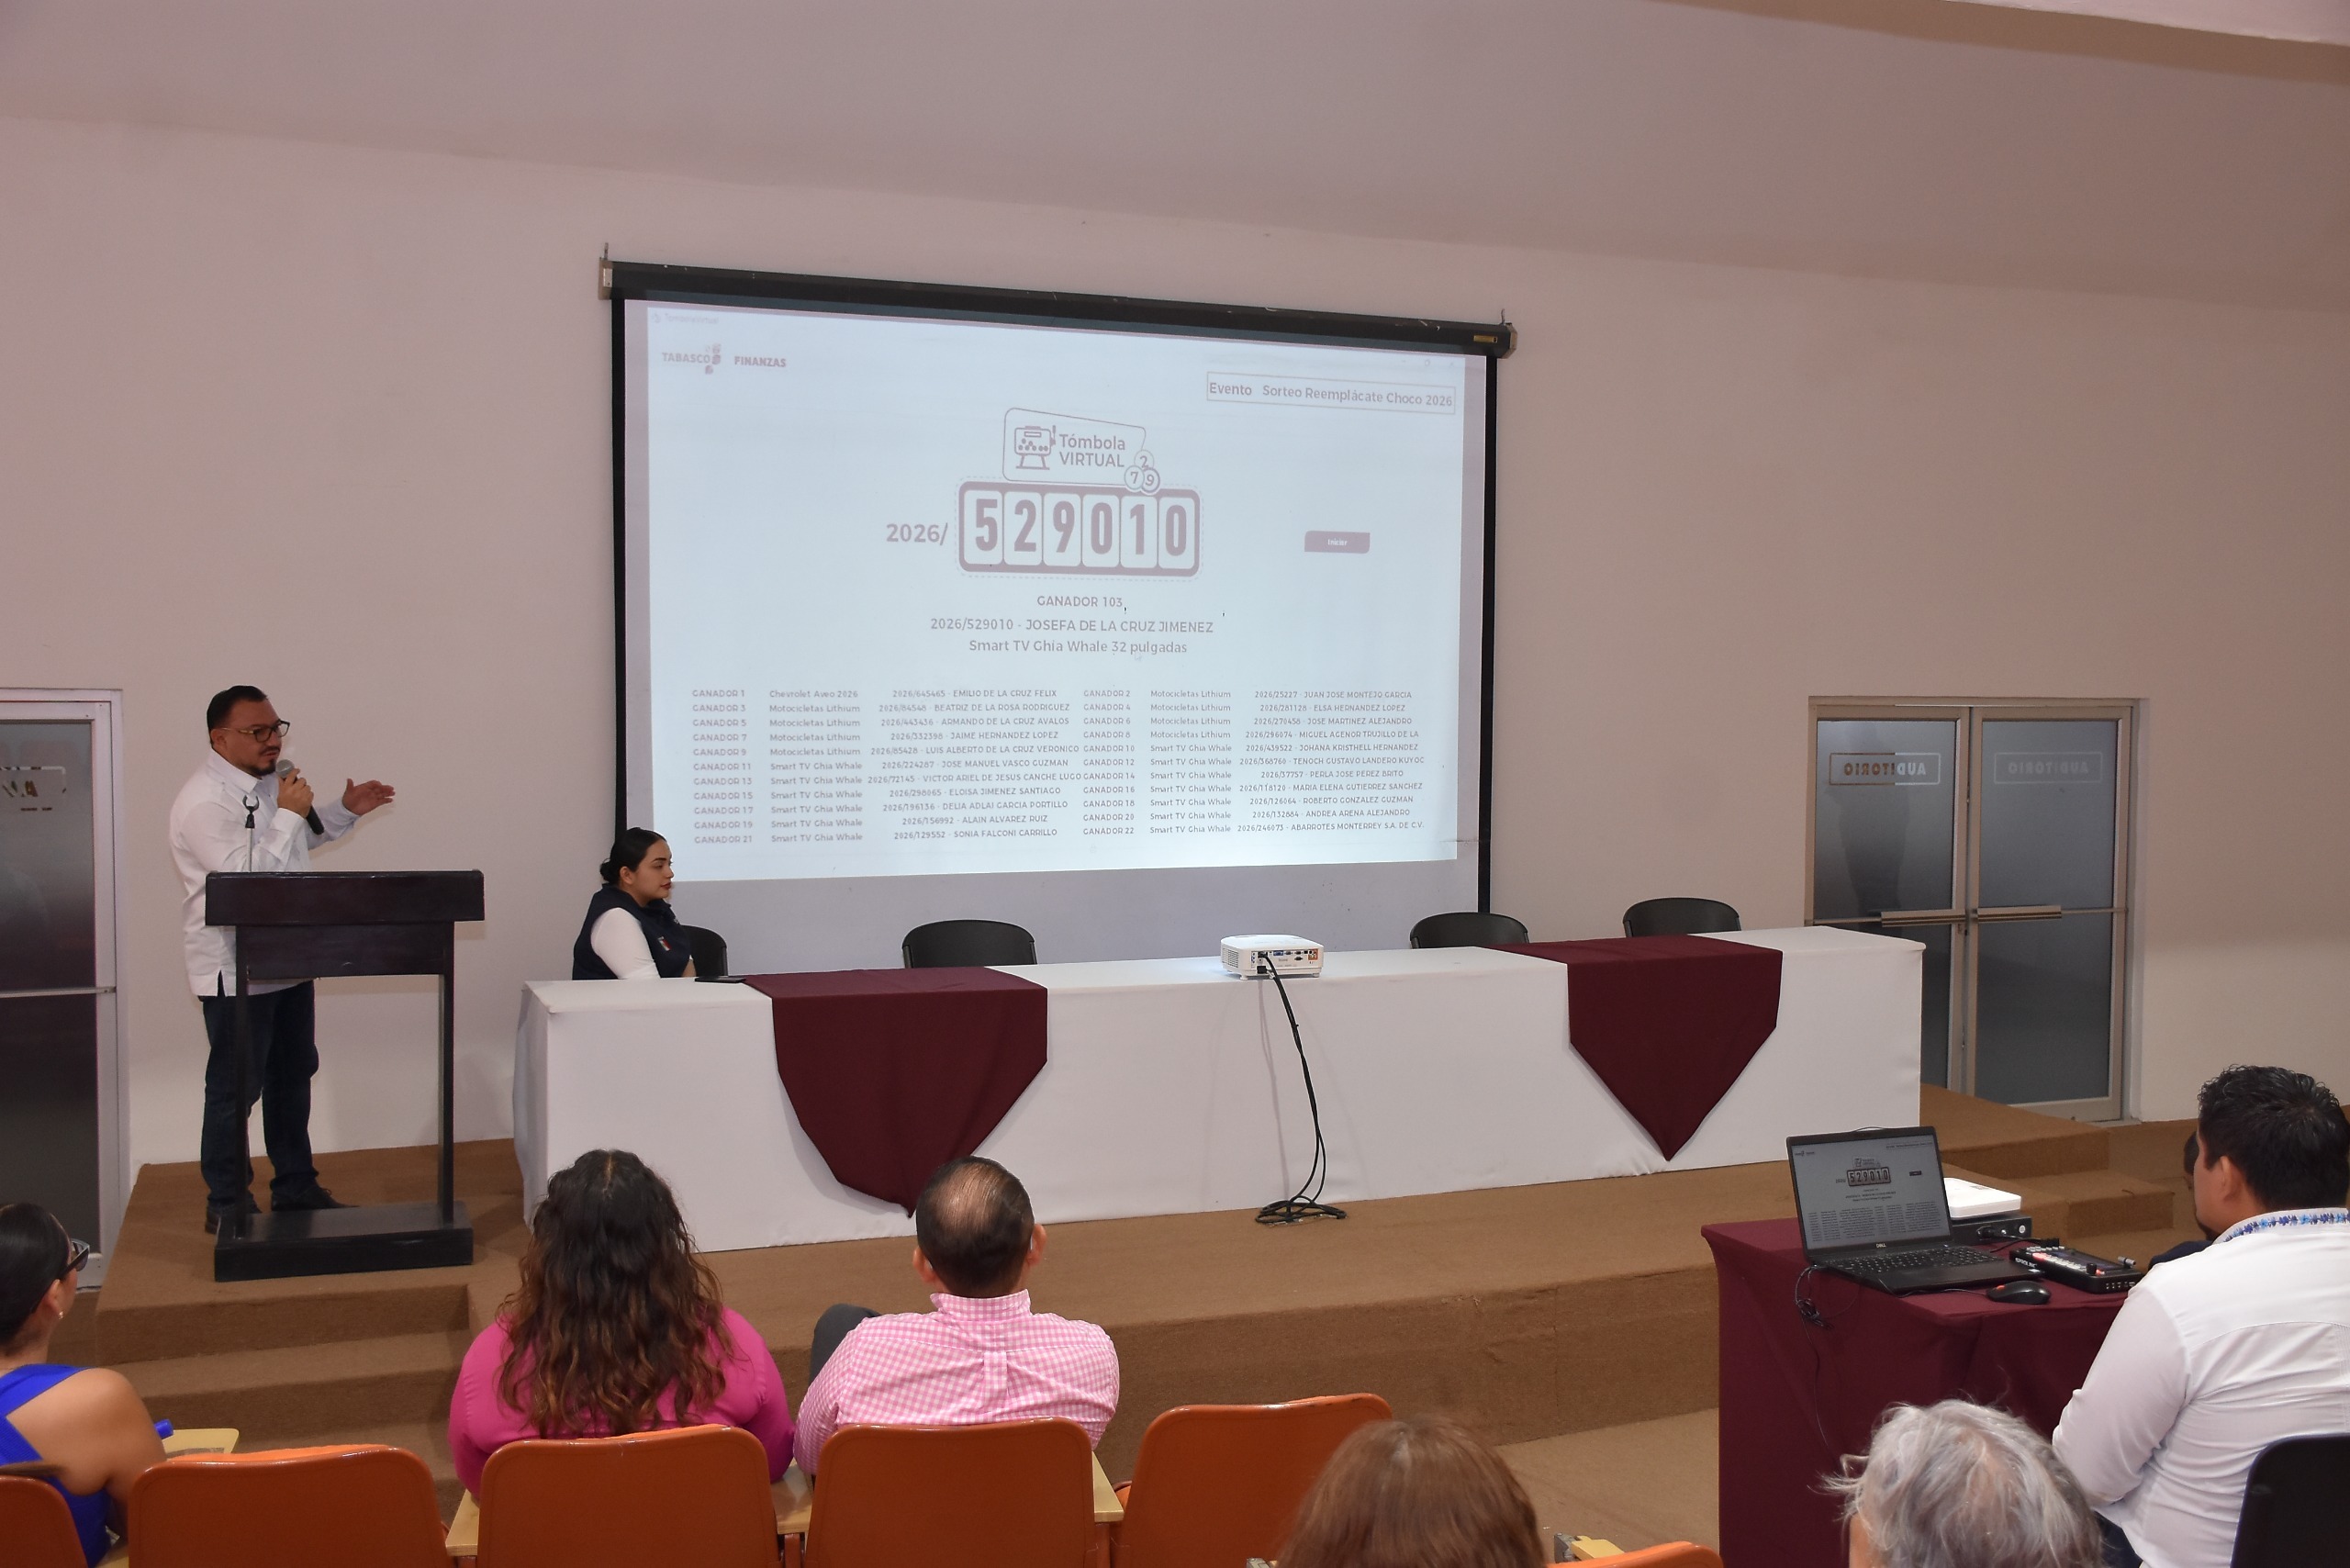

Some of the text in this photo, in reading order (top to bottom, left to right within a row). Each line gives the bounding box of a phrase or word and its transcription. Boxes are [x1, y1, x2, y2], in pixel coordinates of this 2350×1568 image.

[662, 352, 711, 364] TABASCO
[734, 356, 787, 367] FINANZAS
[1209, 382, 1252, 397] Evento
[1262, 385, 1452, 407] Sorteo Reemplácate Choco 2026
[1059, 433, 1126, 451] Tómbola
[1059, 453, 1125, 467] VIRTUAL
[1139, 455, 1149, 468] 2
[1130, 472, 1139, 484] 7
[1145, 474, 1155, 486] 9
[975, 498, 1188, 556] 529010
[886, 522, 948, 545] 2026/
[1037, 596, 1123, 608] GANADOR 103
[931, 618, 1013, 630] 2026/529010
[1025, 619, 1076, 631] JOSEFA
[1080, 620, 1097, 631] DE
[1101, 620, 1117, 632] LA
[1120, 621, 1156, 632] CRUZ
[1158, 622, 1214, 633] JIMENEZ
[969, 640, 1188, 655] Smart TV Ghia Whale 32 pulgadas
[691, 689, 739, 698] GANADOR
[769, 689, 811, 698] Chevrolet
[953, 689, 981, 698] EMILIO
[692, 704, 739, 712] GANADOR
[826, 704, 860, 712] Lithium
[1022, 703, 1069, 711] RODRIGUEZ
[1151, 703, 1230, 711] Motocicletas Lithium
[692, 734, 739, 742] GANADOR
[826, 733, 860, 741] Lithium
[1033, 731, 1058, 739] LOPEZ
[813, 762, 834, 770] Ghia
[834, 761, 863, 769] Whale
[1002, 758, 1030, 767] VASCO
[1083, 758, 1124, 767] GANADOR
[1189, 757, 1205, 766] Ghia
[1208, 757, 1232, 766] Whale
[693, 763, 740, 771] GANADOR
[1018, 787, 1060, 795] SANTIAGO
[1189, 784, 1205, 792] Ghia
[1208, 784, 1231, 792] Whale
[742, 791, 753, 800] 15
[813, 790, 834, 799] Ghia
[1083, 813, 1124, 822] GANADOR
[694, 821, 754, 829] GANADOR 19
[835, 819, 863, 827] Whale
[1850, 1168, 1889, 1183] 529010
